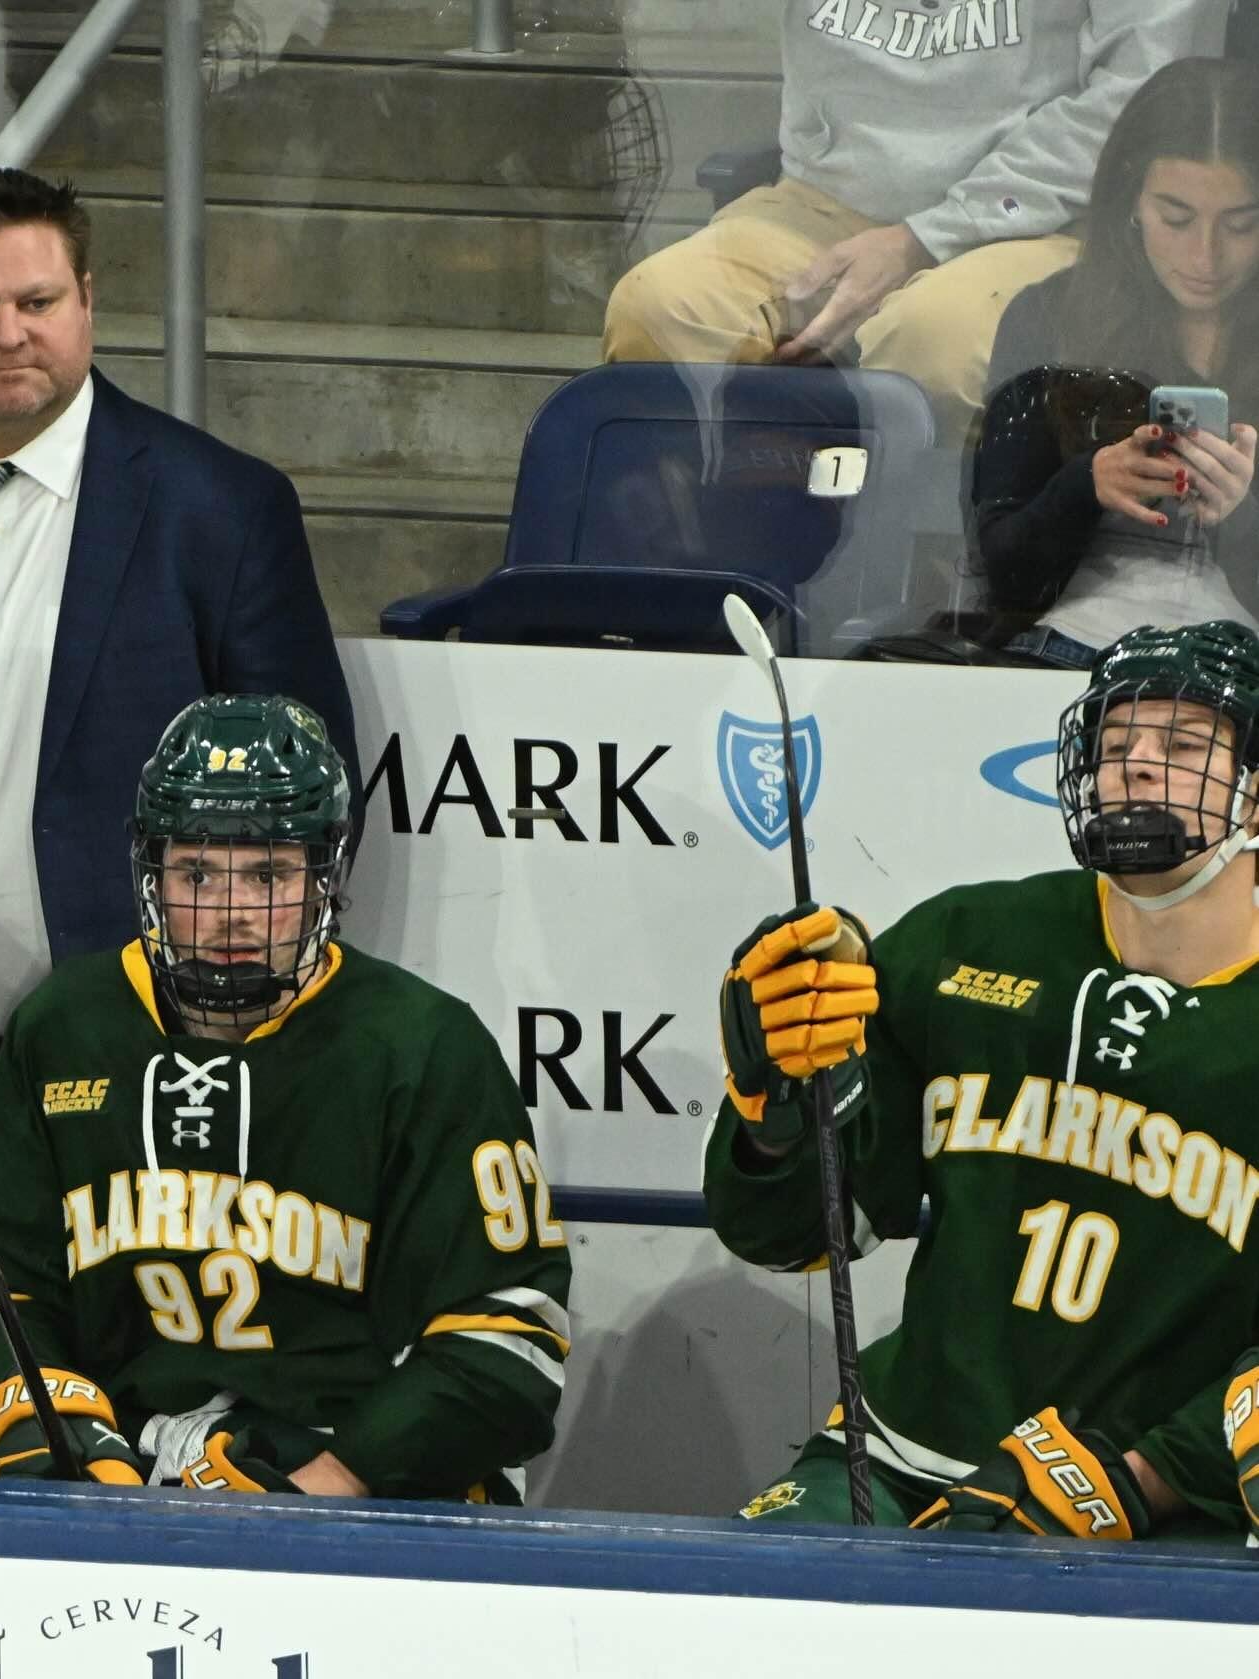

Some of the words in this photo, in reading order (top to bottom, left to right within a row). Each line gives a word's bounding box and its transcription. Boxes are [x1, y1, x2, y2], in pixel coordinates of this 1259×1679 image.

[807, 0, 1021, 60] ALUMNI
[833, 455, 841, 488] 1
[207, 746, 248, 773] 92
[951, 965, 1040, 997] ECAC
[956, 984, 1028, 1009] HOCKEY
[43, 1078, 110, 1102] ECAC
[922, 1073, 1259, 1254] CLARKSON
[472, 1139, 568, 1252] 92
[62, 1168, 371, 1292] LARKSON
[1012, 1199, 1120, 1323] 10
[133, 1249, 274, 1350] 92
[40, 1597, 224, 1652] CERVEZA
